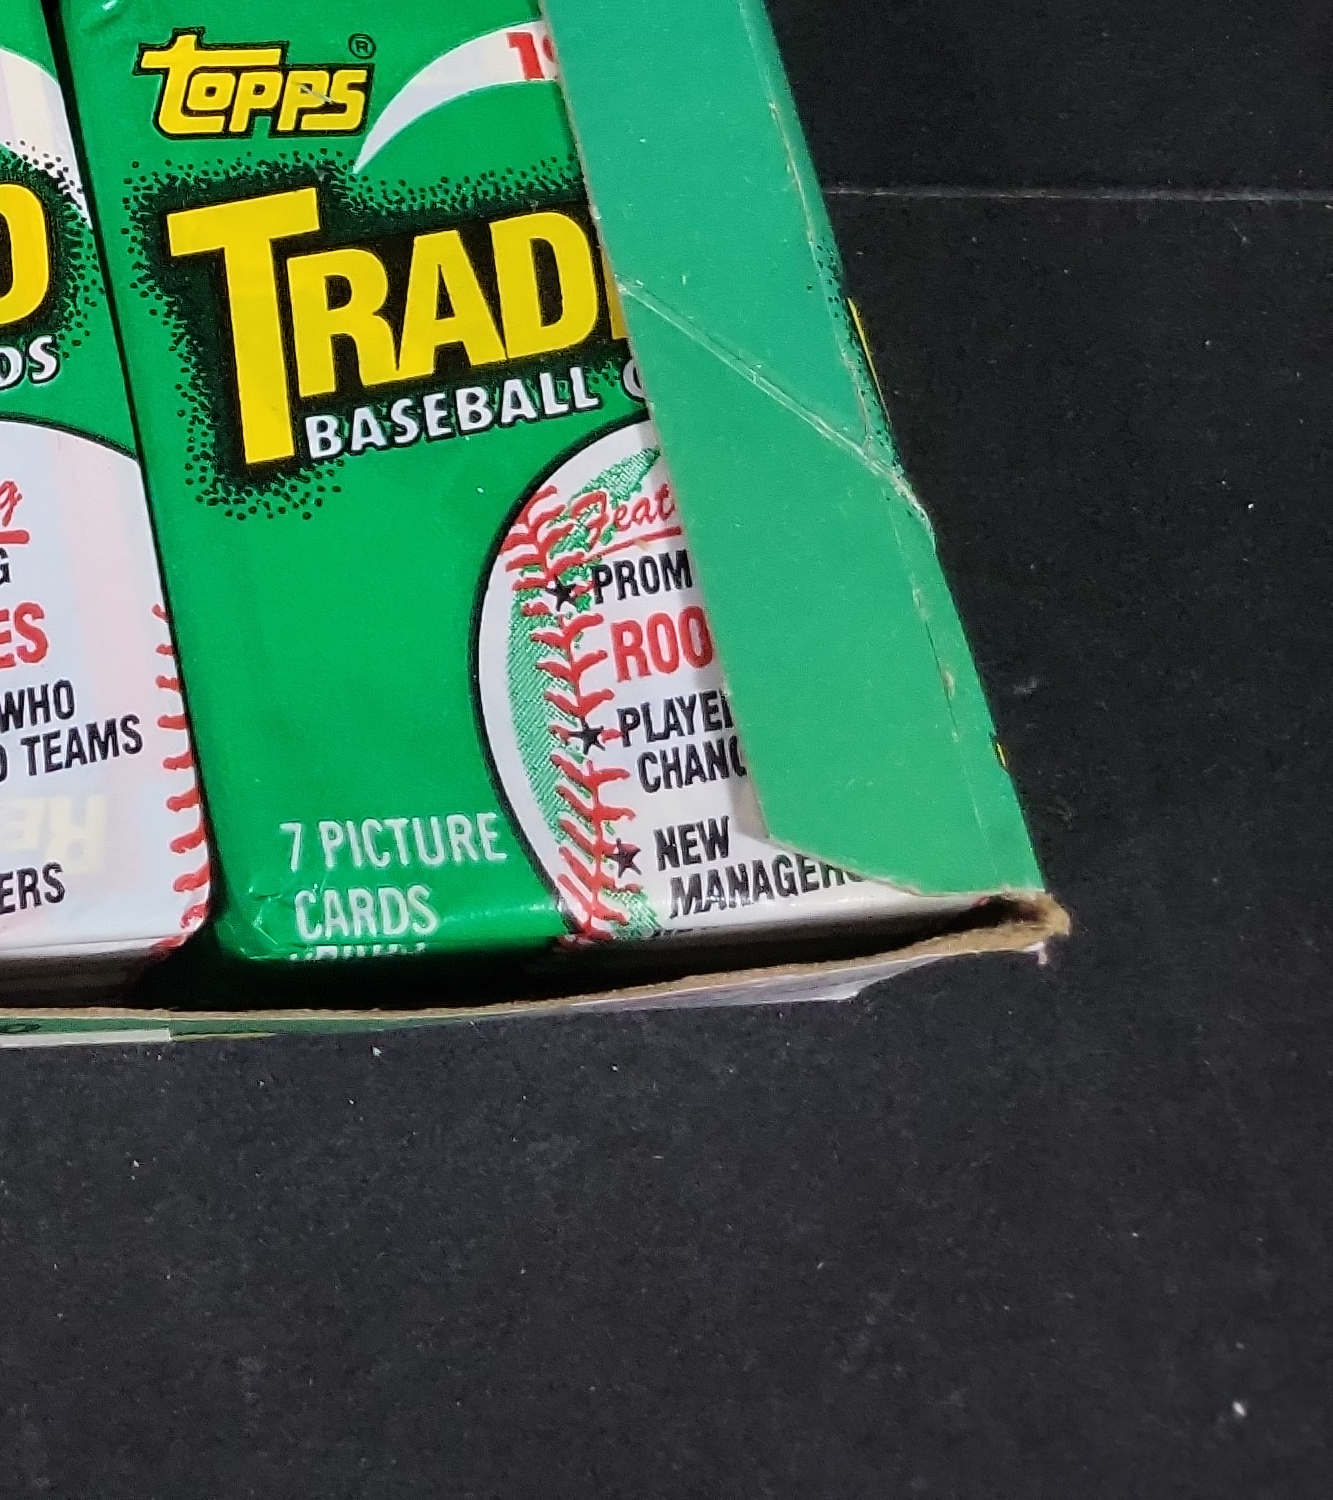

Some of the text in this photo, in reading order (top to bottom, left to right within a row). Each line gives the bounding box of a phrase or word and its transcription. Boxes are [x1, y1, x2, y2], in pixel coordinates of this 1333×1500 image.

[166, 187, 631, 464] TRAD
[305, 366, 599, 459] BASEBALL
[20, 714, 143, 777] TEAMS
[280, 811, 507, 871] 7 PICTURE
[654, 815, 729, 871] NEW
[294, 884, 436, 941] CARDS
